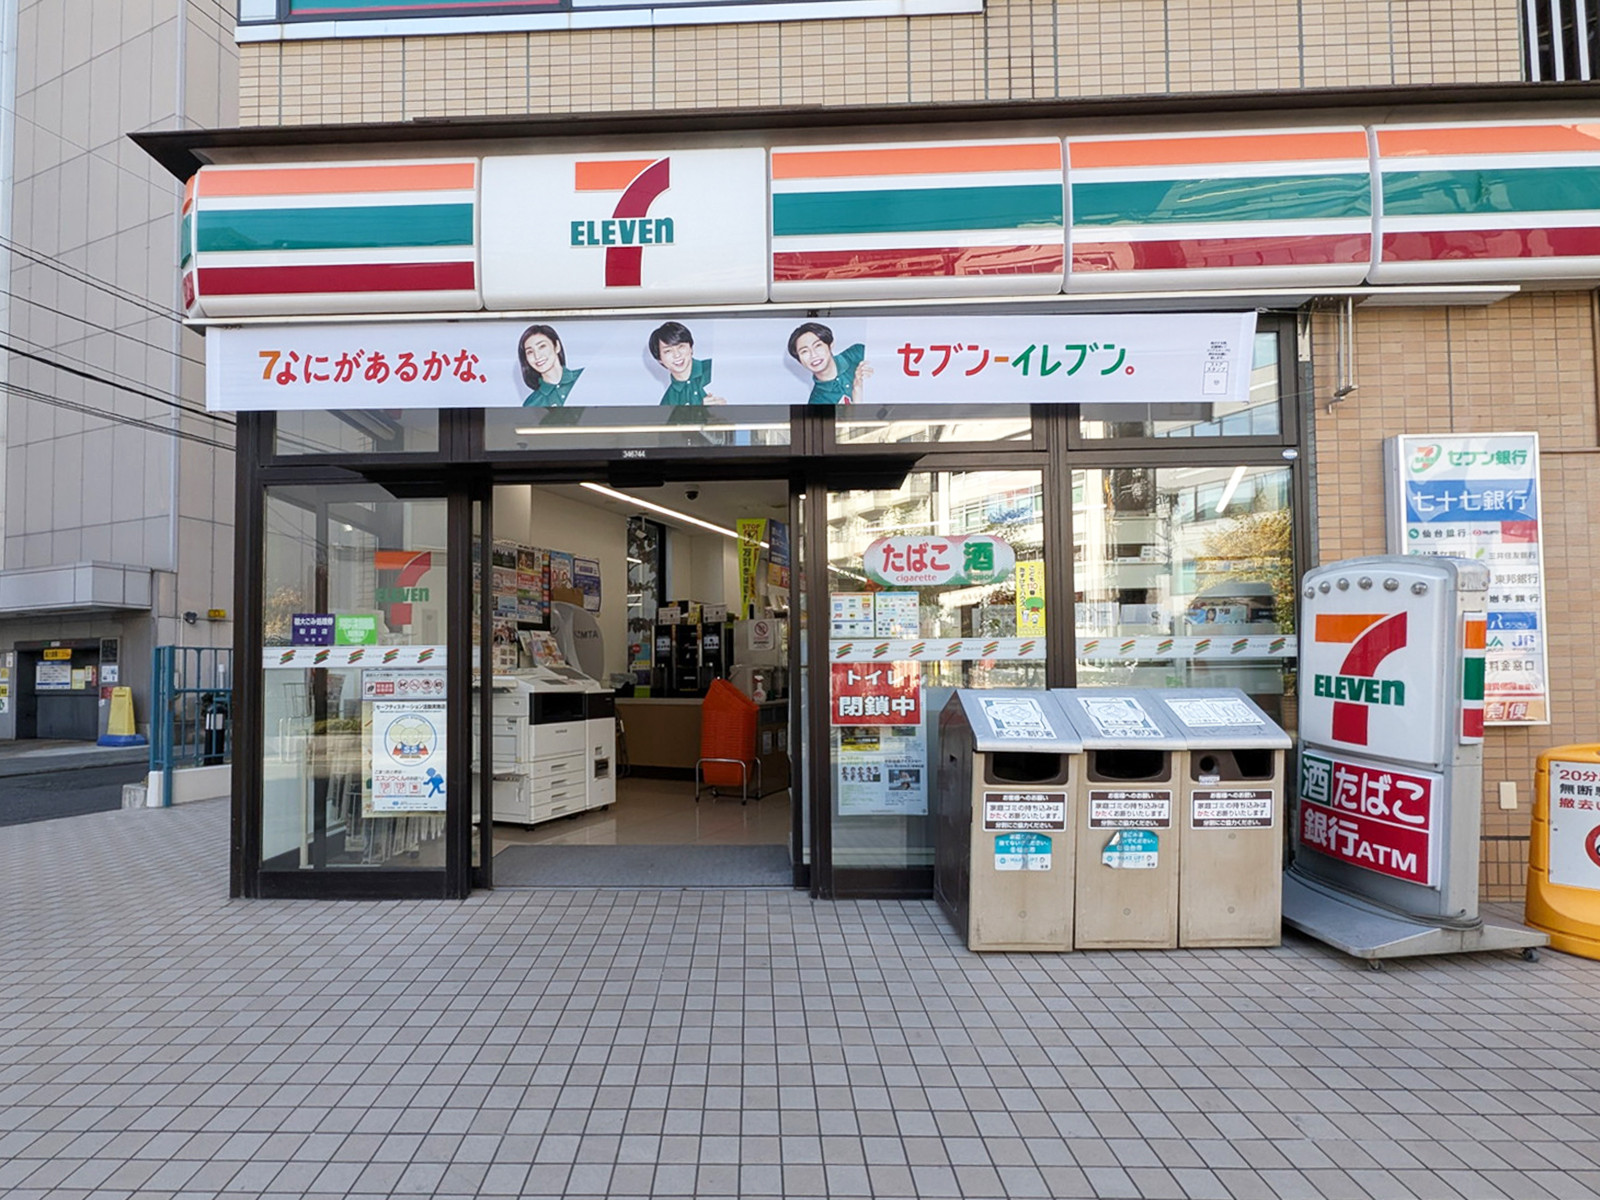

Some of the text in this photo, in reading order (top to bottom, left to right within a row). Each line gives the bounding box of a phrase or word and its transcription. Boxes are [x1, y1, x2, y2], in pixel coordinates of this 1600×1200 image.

[1412, 490, 1528, 512] 七十七銀行
[1422, 529, 1467, 538] 仙台銀行
[882, 541, 994, 573] たばこ 酒
[896, 574, 937, 583] cigarette
[1494, 573, 1539, 585] 東邦銀行
[1485, 660, 1535, 672] 料金窓口
[839, 695, 916, 717] 閉鎖中
[1559, 769, 1600, 782] 20分
[1302, 757, 1426, 825] 酒 たばこ
[989, 804, 1060, 812] 家庭ゴミの持ち込みは
[1094, 802, 1165, 810] 家庭ゴミの持ち込みは
